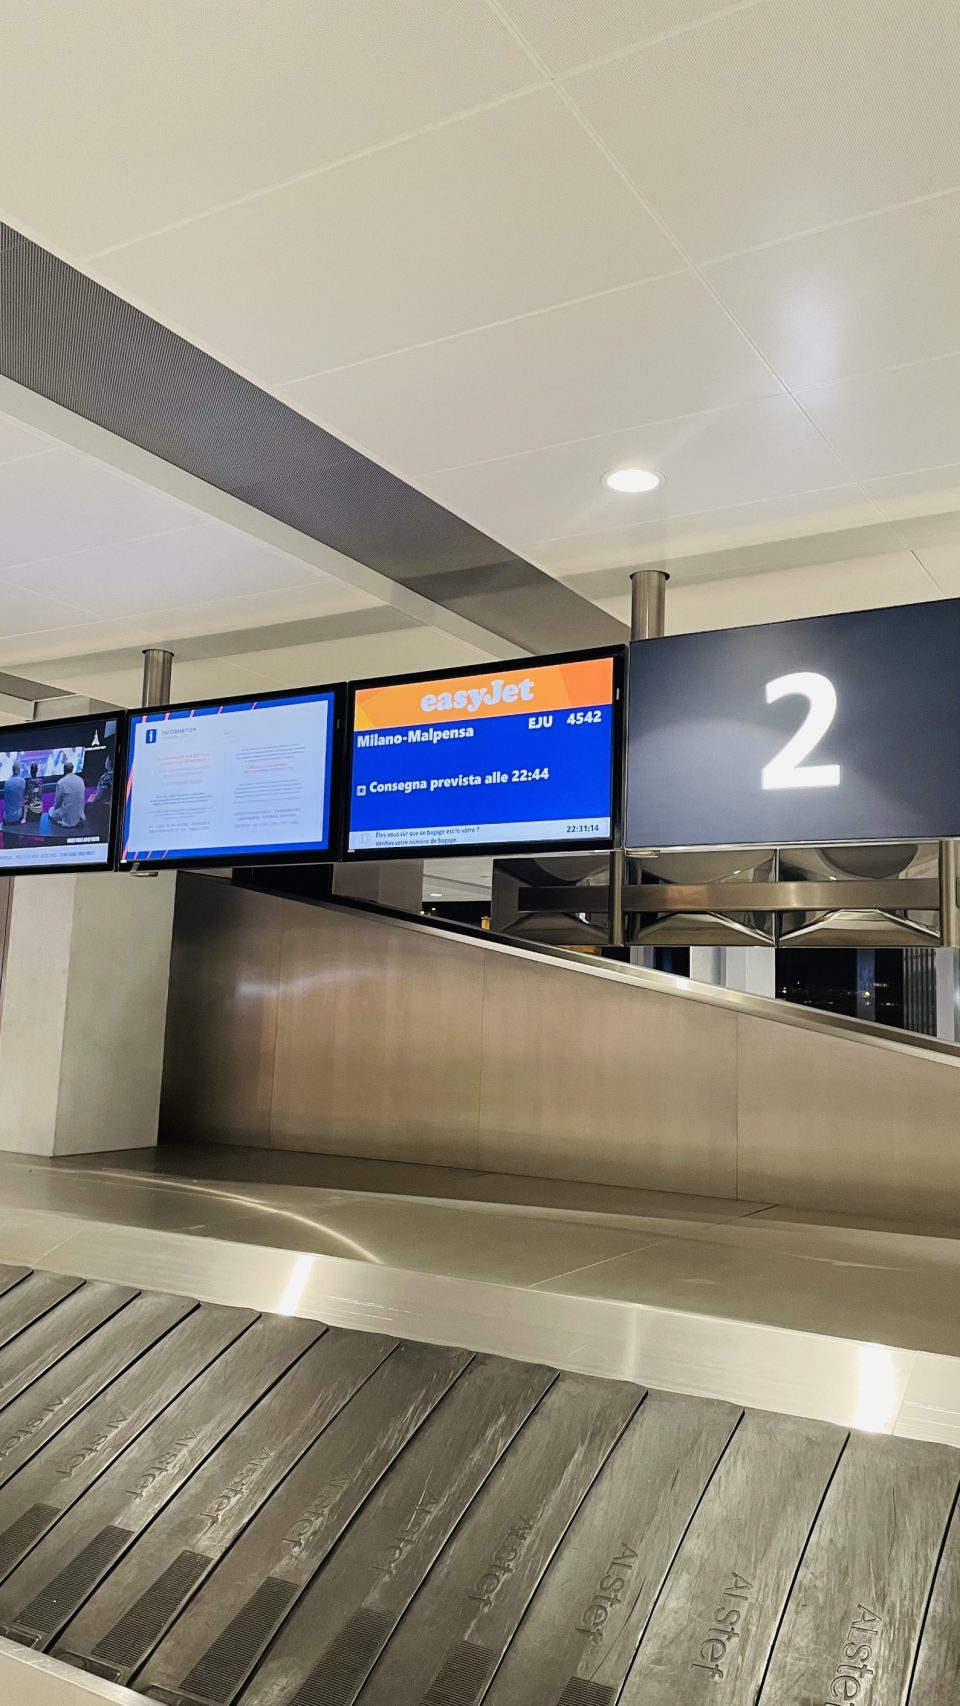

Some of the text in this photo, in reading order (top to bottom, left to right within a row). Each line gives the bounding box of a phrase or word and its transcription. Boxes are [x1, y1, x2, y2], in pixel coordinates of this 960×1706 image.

[420, 678, 535, 713] easyJet
[528, 710, 602, 730] EJU 4542
[761, 671, 841, 790] 2
[357, 727, 474, 748] Milano-Malpensa
[369, 767, 550, 794] Consegna prevista alle 22:44
[566, 824, 600, 833] 22:31:14
